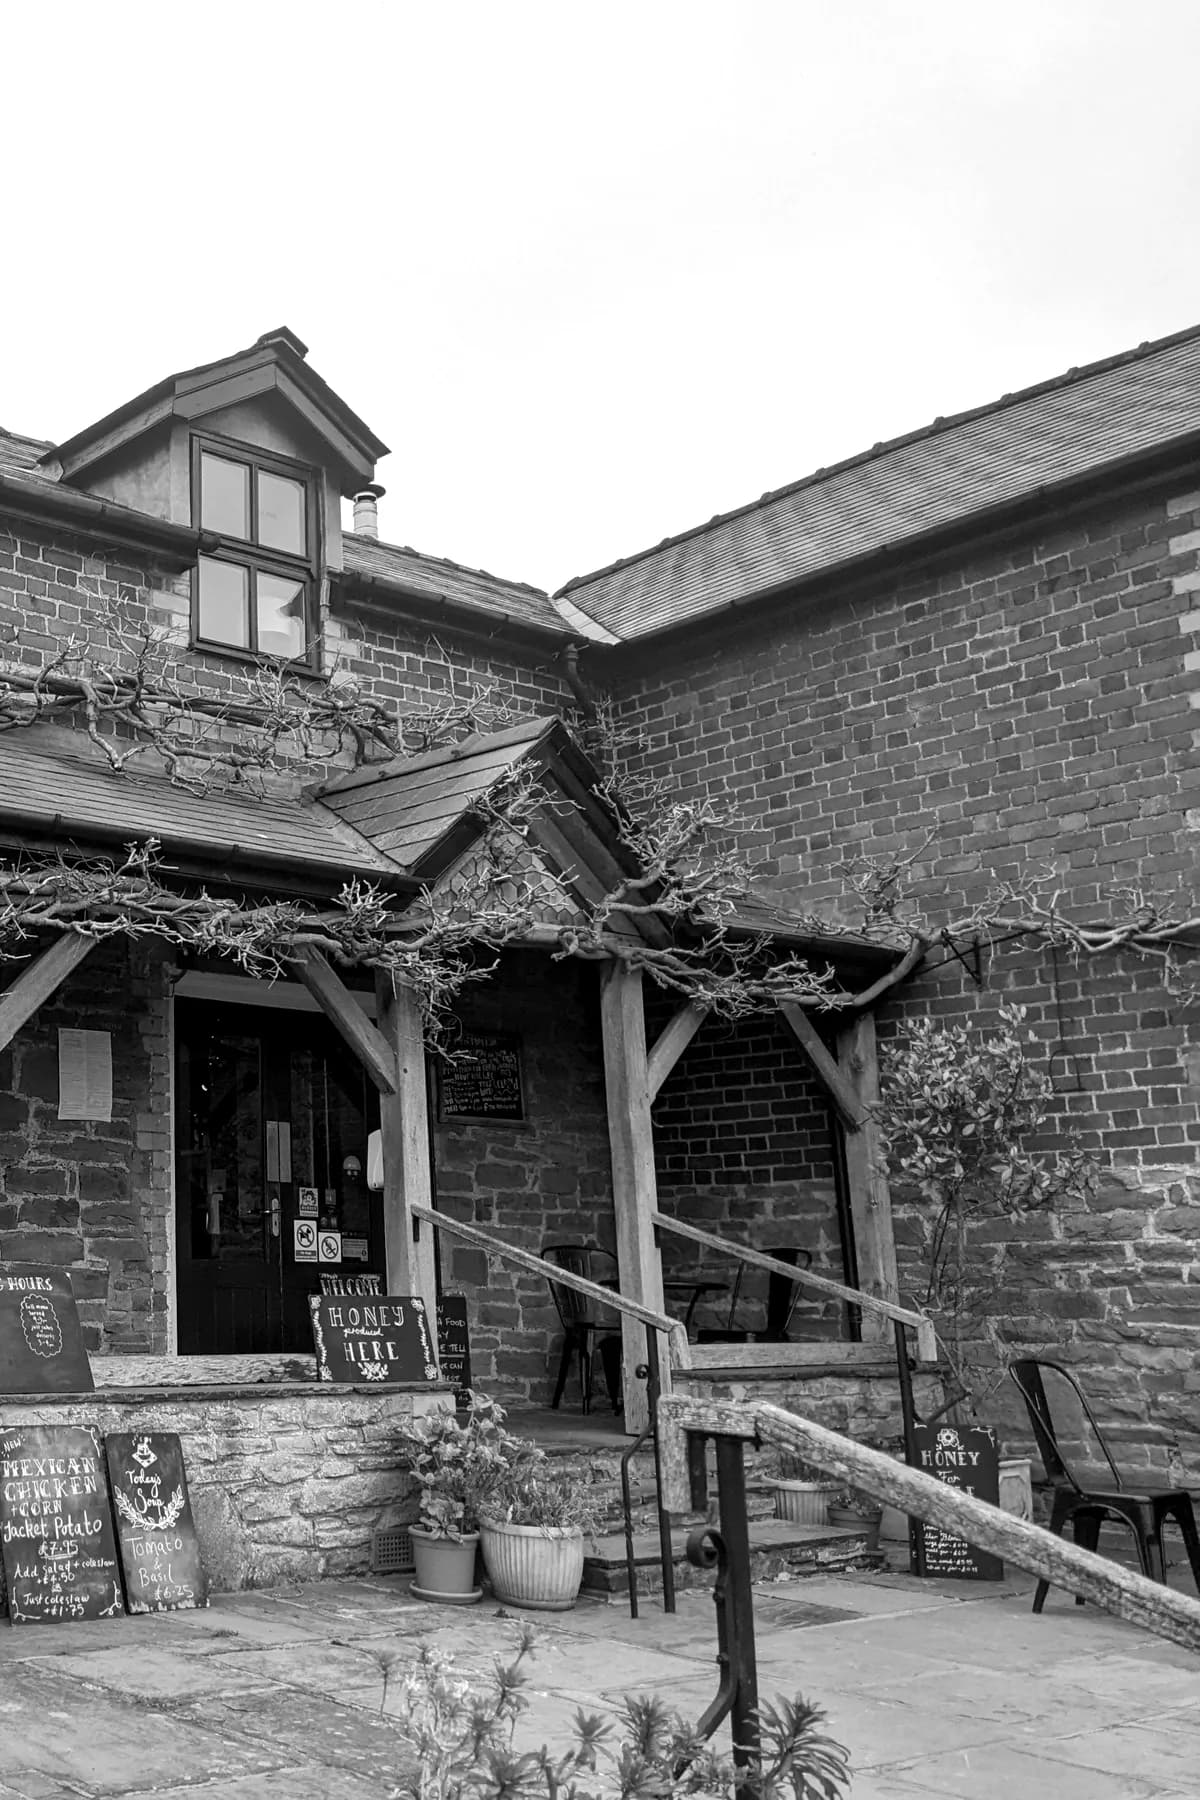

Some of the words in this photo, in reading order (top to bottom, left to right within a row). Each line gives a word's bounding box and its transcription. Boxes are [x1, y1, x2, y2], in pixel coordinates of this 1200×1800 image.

[7, 1276, 53, 1291] HOURS
[319, 1278, 383, 1296] WELCOME
[328, 1306, 405, 1327] HONEY
[445, 1317, 466, 1328] FOOD
[343, 1328, 384, 1338] produced
[343, 1340, 399, 1362] HERE
[449, 1343, 467, 1353] TELL
[449, 1361, 463, 1370] CAN
[3, 1439, 22, 1452] NEW
[0, 1457, 96, 1478] MEXICAN
[920, 1450, 980, 1467] HONEY
[936, 1470, 961, 1484] For
[4, 1475, 97, 1501] CHICKEN
[134, 1487, 165, 1520] Soup
[3, 1517, 49, 1543] Jacket
[54, 1509, 102, 1540] Potato
[38, 1539, 79, 1557] £7.95
[124, 1535, 183, 1560] Tomato
[14, 1562, 39, 1579] Add
[42, 1560, 71, 1573] salad
[81, 1557, 115, 1569] coleslaw
[139, 1563, 176, 1588] Basil
[23, 1592, 43, 1606] Just
[44, 1593, 90, 1605] coleslaw
[154, 1584, 194, 1600] £6.25
